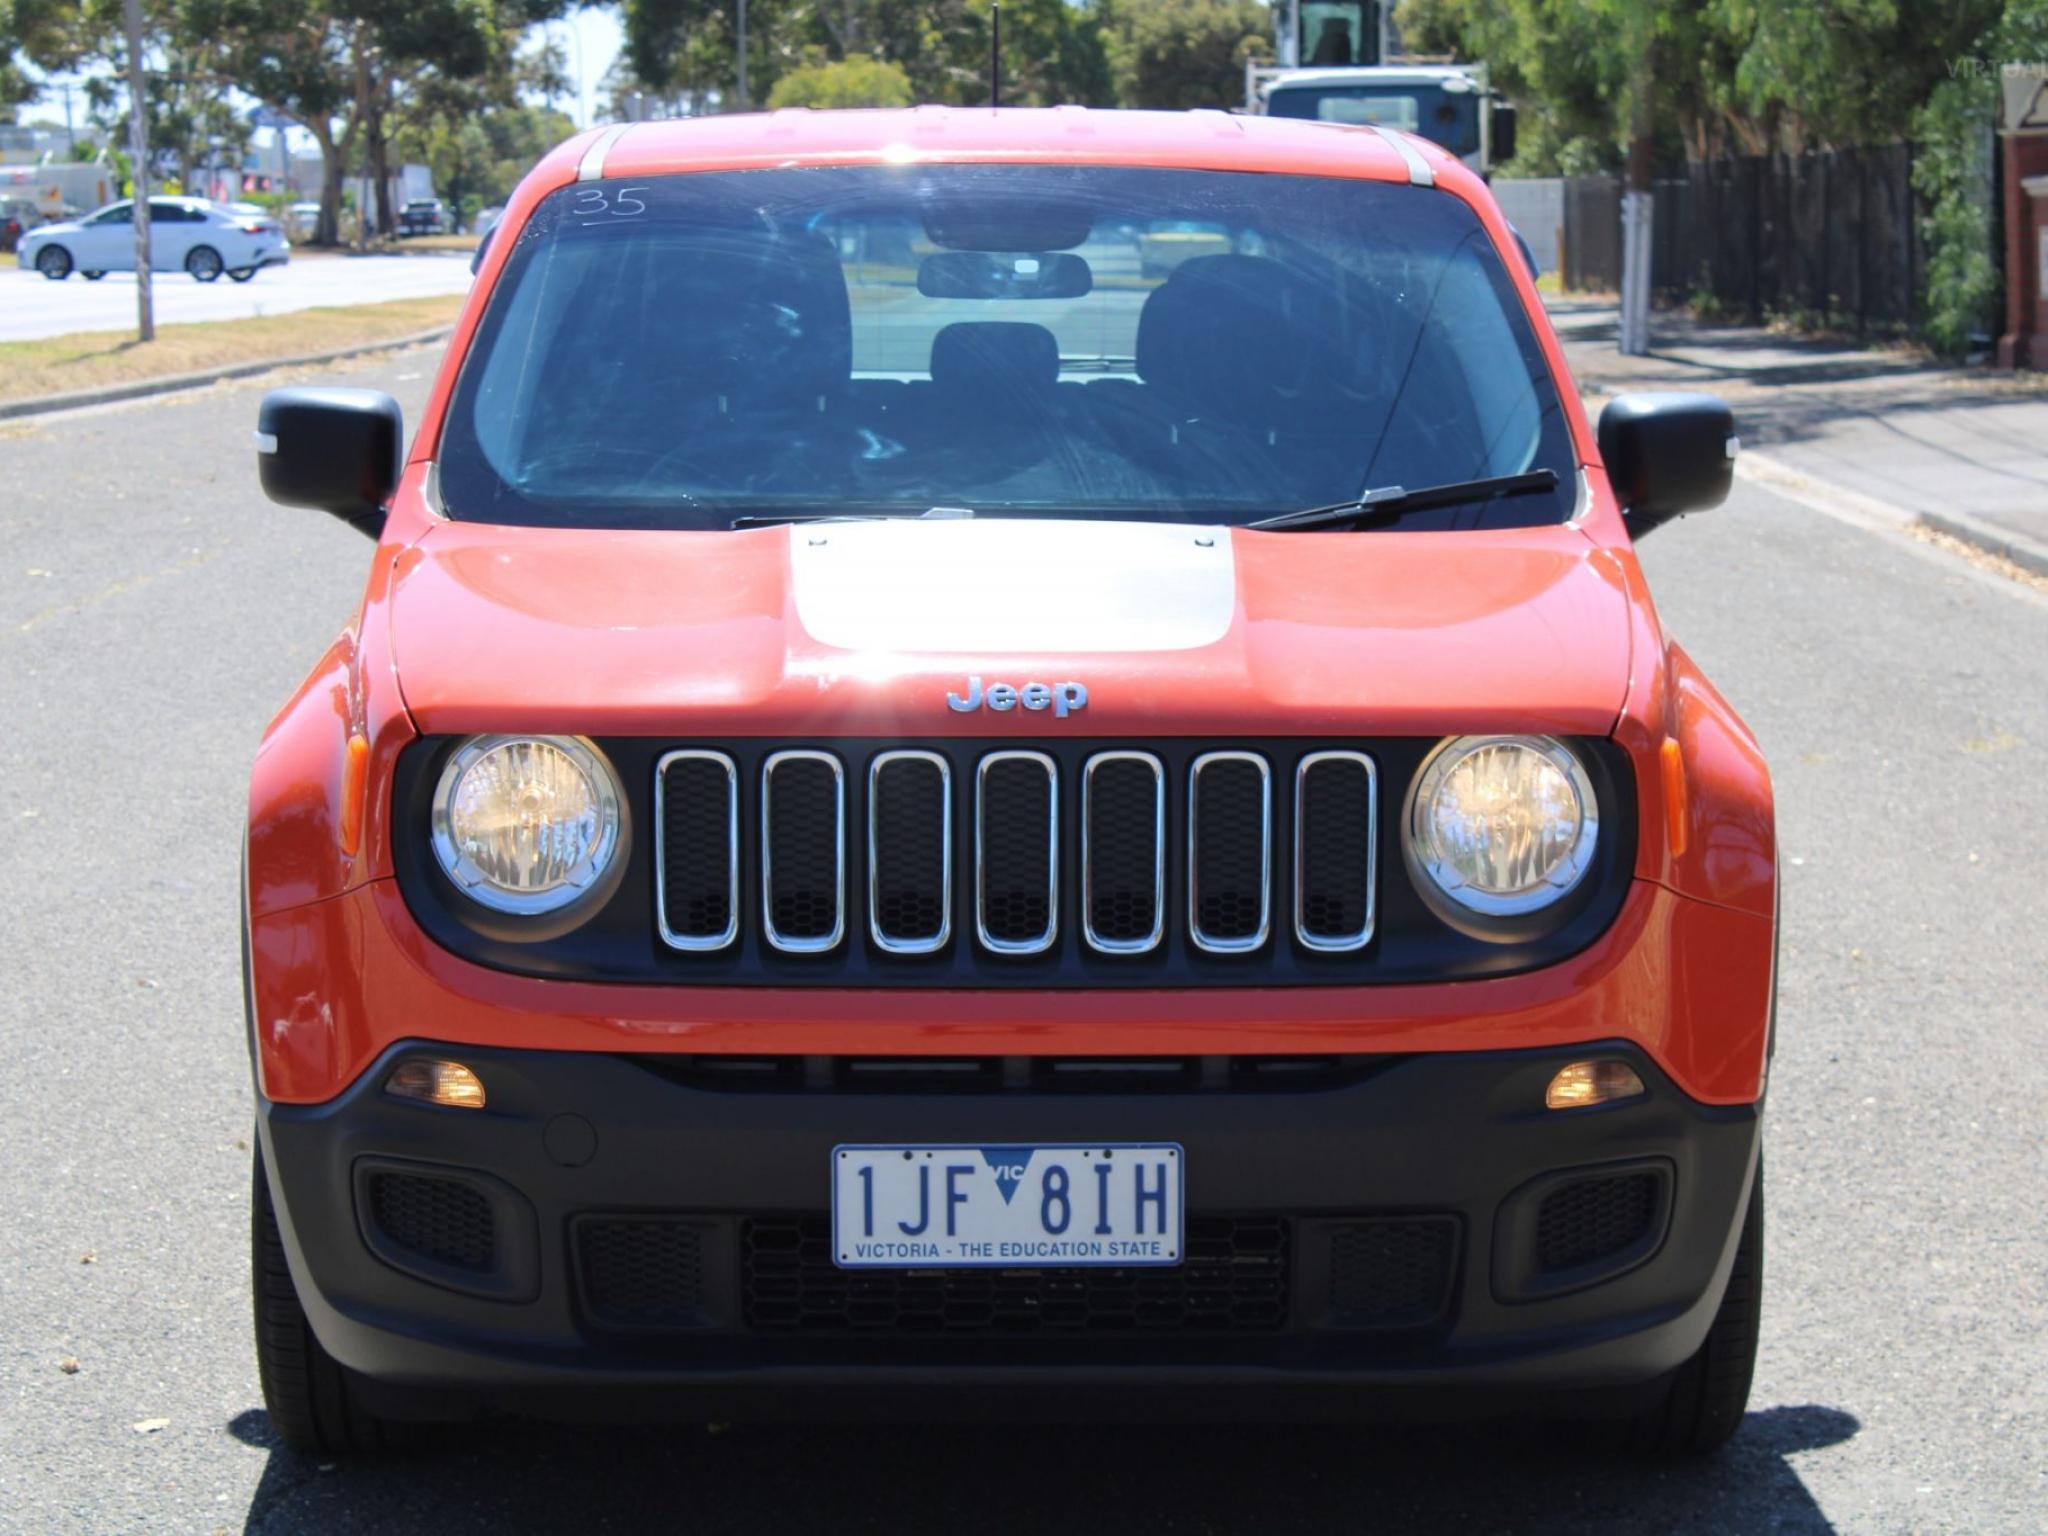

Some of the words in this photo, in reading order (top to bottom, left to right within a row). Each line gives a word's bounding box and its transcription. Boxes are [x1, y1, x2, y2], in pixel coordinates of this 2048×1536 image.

[573, 187, 650, 215] 35
[946, 675, 1088, 718] Jeep
[990, 1165, 1025, 1180] VIC
[858, 1165, 976, 1237] 1JF
[1040, 1163, 1167, 1236] 8IH
[855, 1243, 940, 1259] VICTORIA
[959, 1243, 992, 1258] THE
[1000, 1242, 1102, 1258] EDUCATION
[1108, 1241, 1161, 1257] STATE
